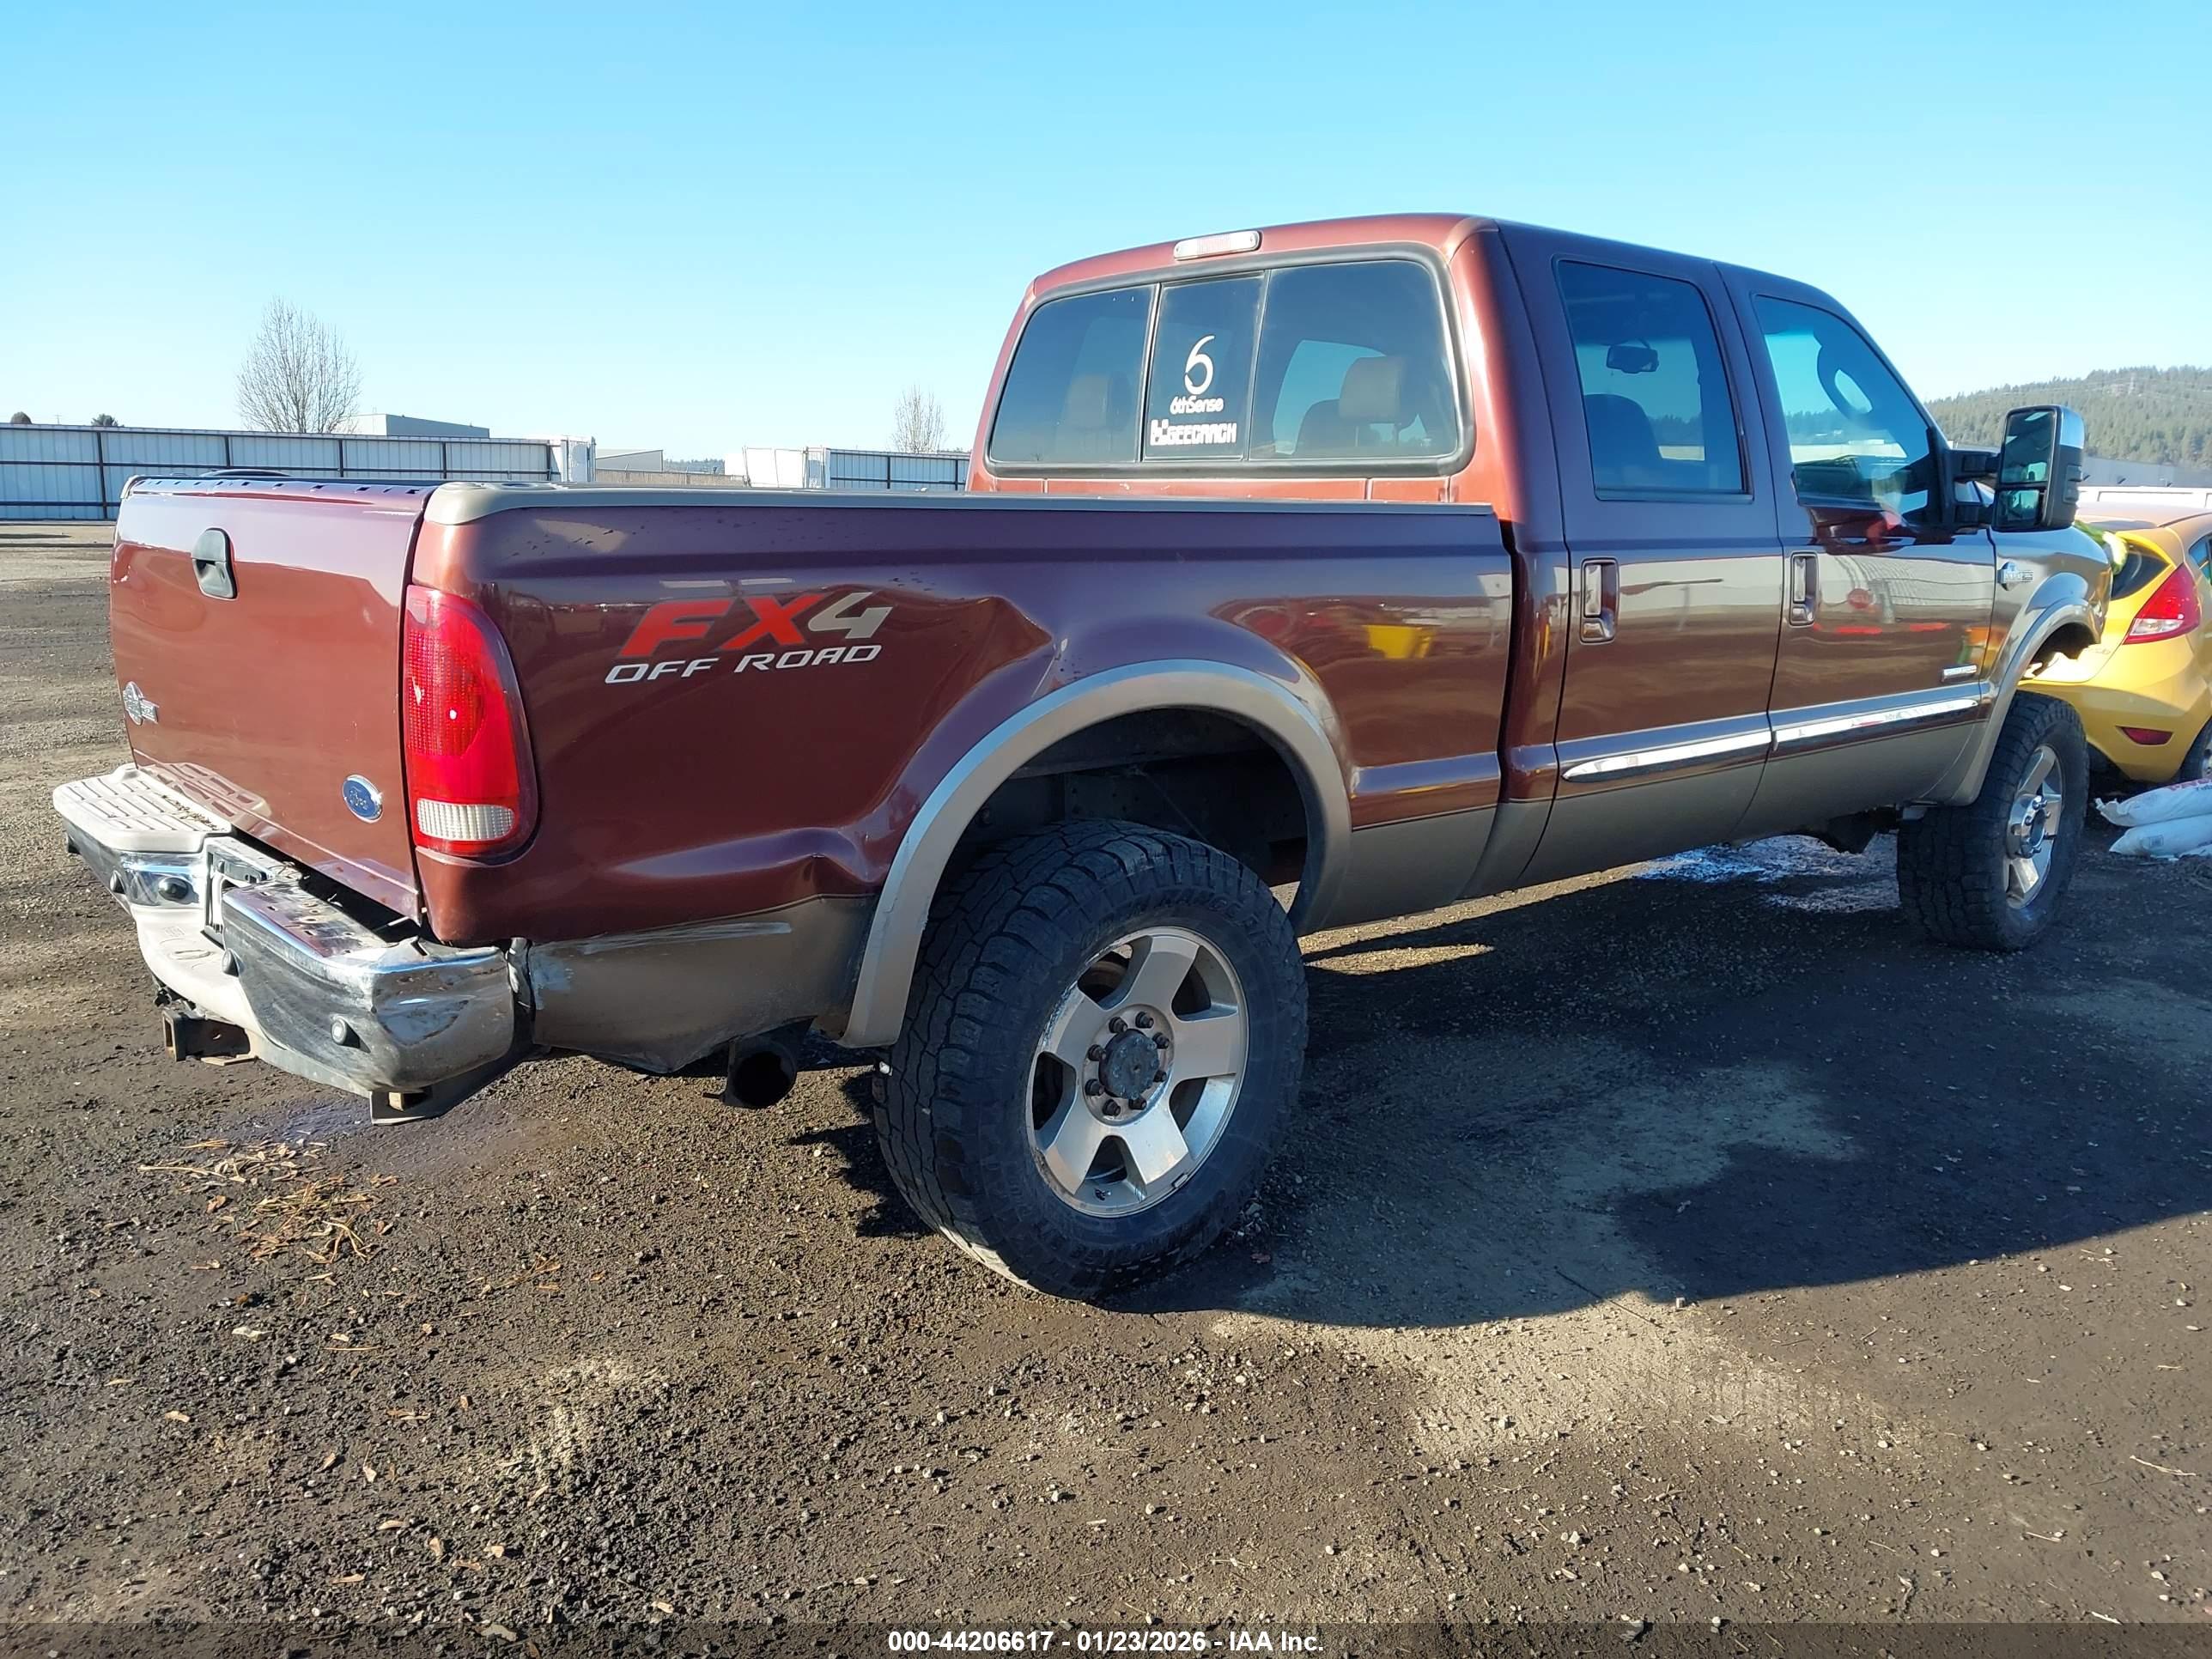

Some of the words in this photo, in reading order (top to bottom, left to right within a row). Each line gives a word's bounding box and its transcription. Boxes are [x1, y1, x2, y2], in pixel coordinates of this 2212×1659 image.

[1185, 335, 1215, 395] 6
[618, 591, 894, 657] FX4
[605, 657, 720, 684] OFF
[733, 644, 882, 673] ROAD
